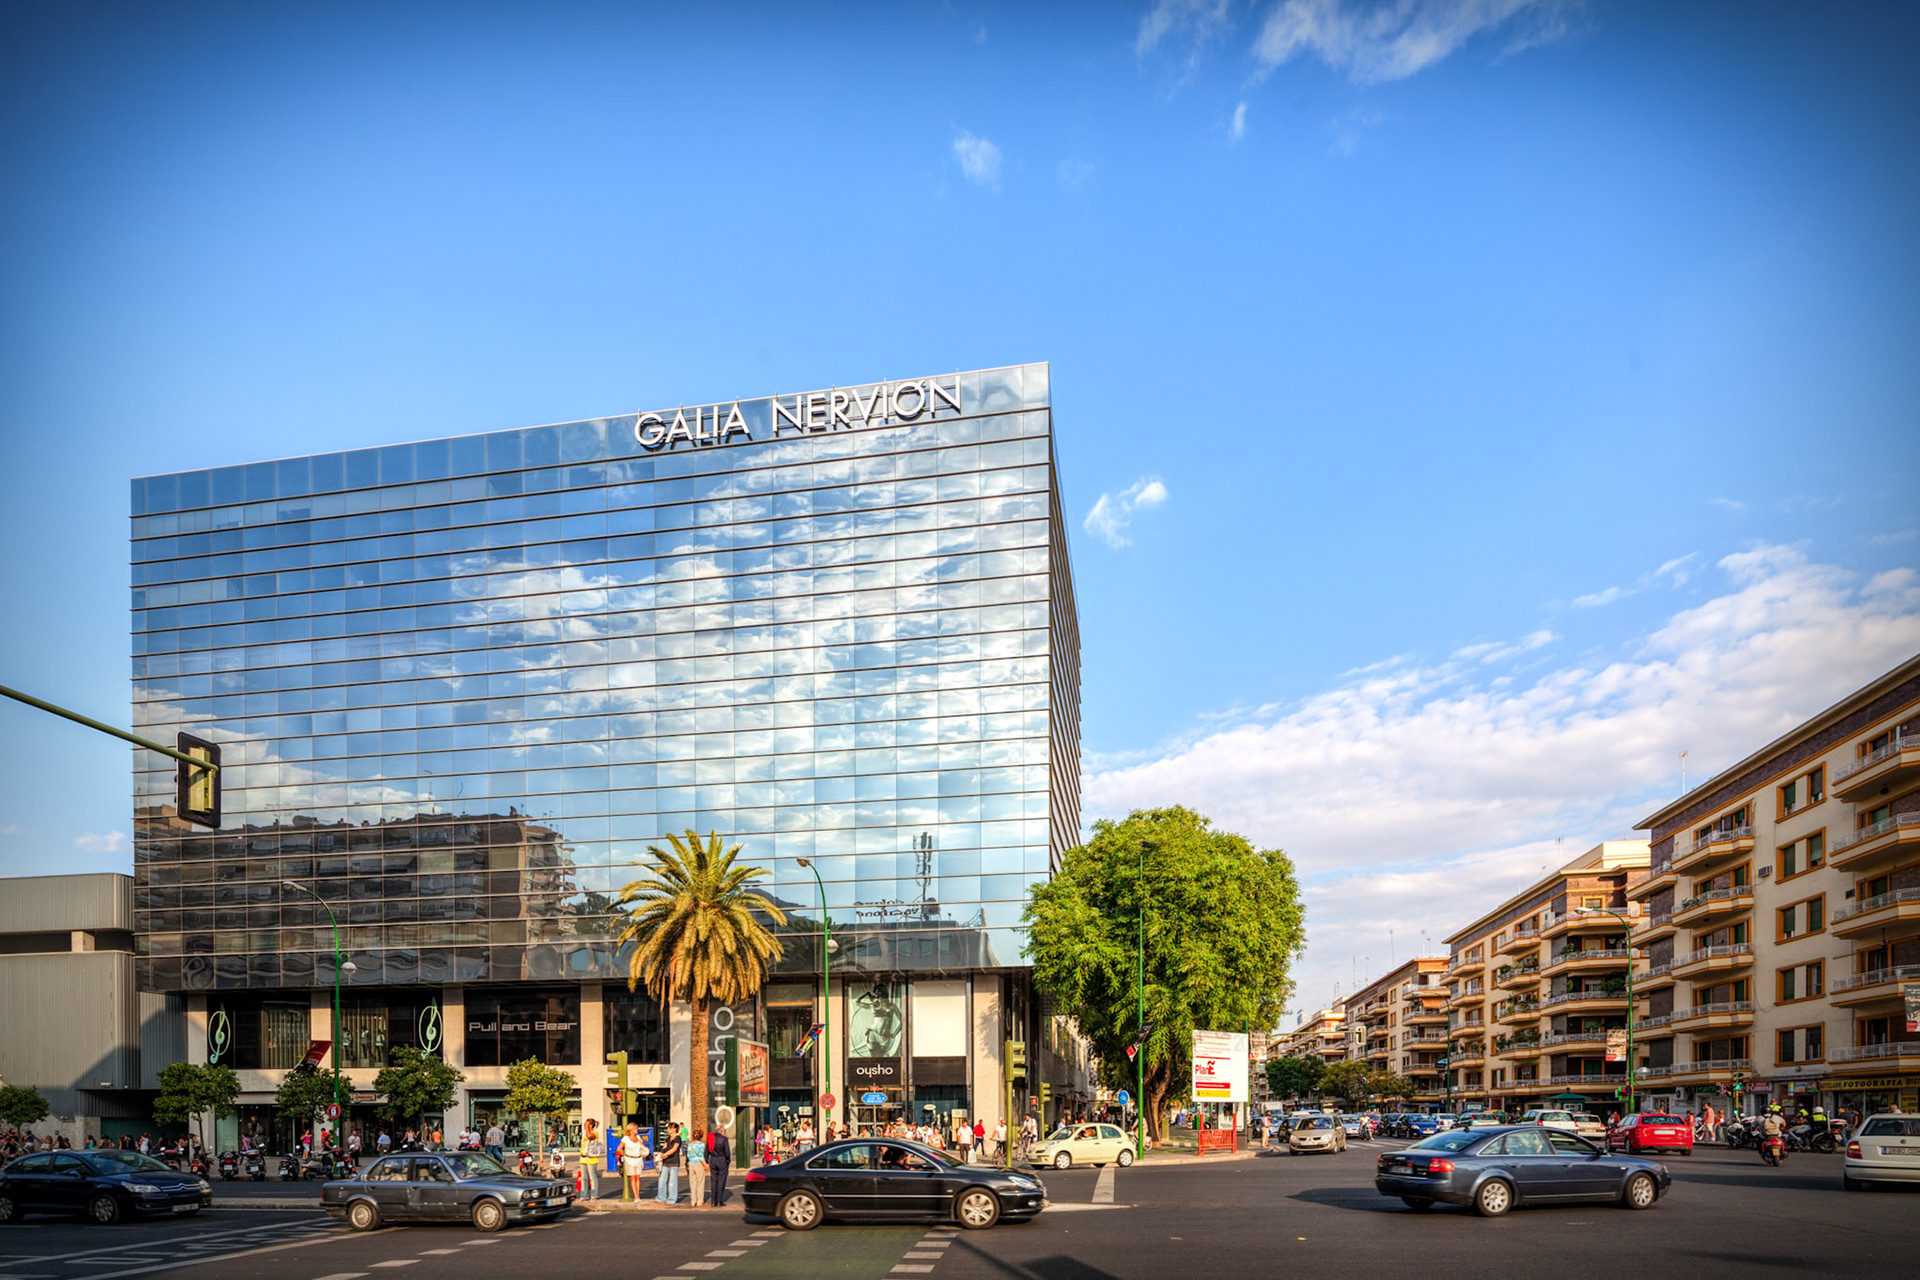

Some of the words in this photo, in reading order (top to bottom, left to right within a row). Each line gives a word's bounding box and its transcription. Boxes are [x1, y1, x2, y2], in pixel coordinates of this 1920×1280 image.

[634, 402, 750, 447] GALIA
[468, 1021, 497, 1032] Pull
[501, 1023, 530, 1031] and
[534, 1021, 578, 1031] Bear
[856, 1063, 894, 1078] oysho
[1843, 1079, 1903, 1088] FOTOGRAFIA
